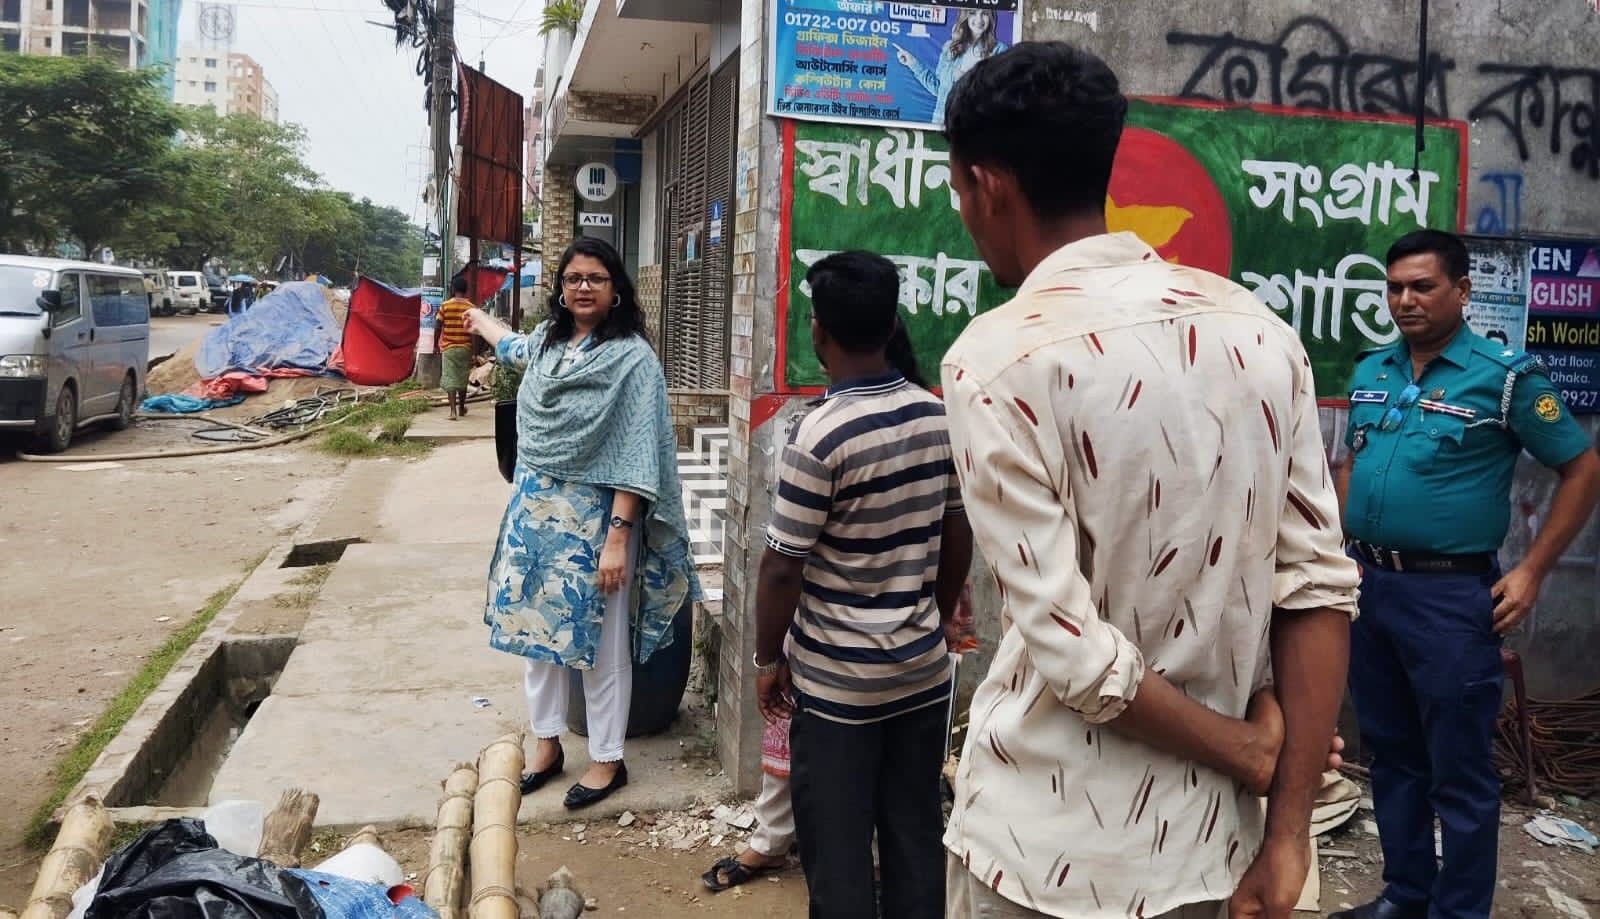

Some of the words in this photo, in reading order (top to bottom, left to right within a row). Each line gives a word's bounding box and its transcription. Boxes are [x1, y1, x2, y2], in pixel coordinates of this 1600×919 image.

[785, 12, 867, 33] 01722-007
[870, 21, 900, 34] 005
[842, 31, 888, 48] ডিজাইন
[862, 63, 888, 77] কোর্স
[859, 78, 887, 92] কোর্স
[795, 128, 960, 211] স্বাধীন
[1242, 159, 1439, 229] সংগ্রাম
[583, 215, 610, 224] ATM
[1530, 282, 1592, 308] GLISH
[1528, 321, 1546, 343] sh
[1552, 322, 1600, 346] World
[1548, 355, 1567, 367] 3rd
[1550, 371, 1592, 384] Dhaka.
[1560, 389, 1598, 407] 9927
